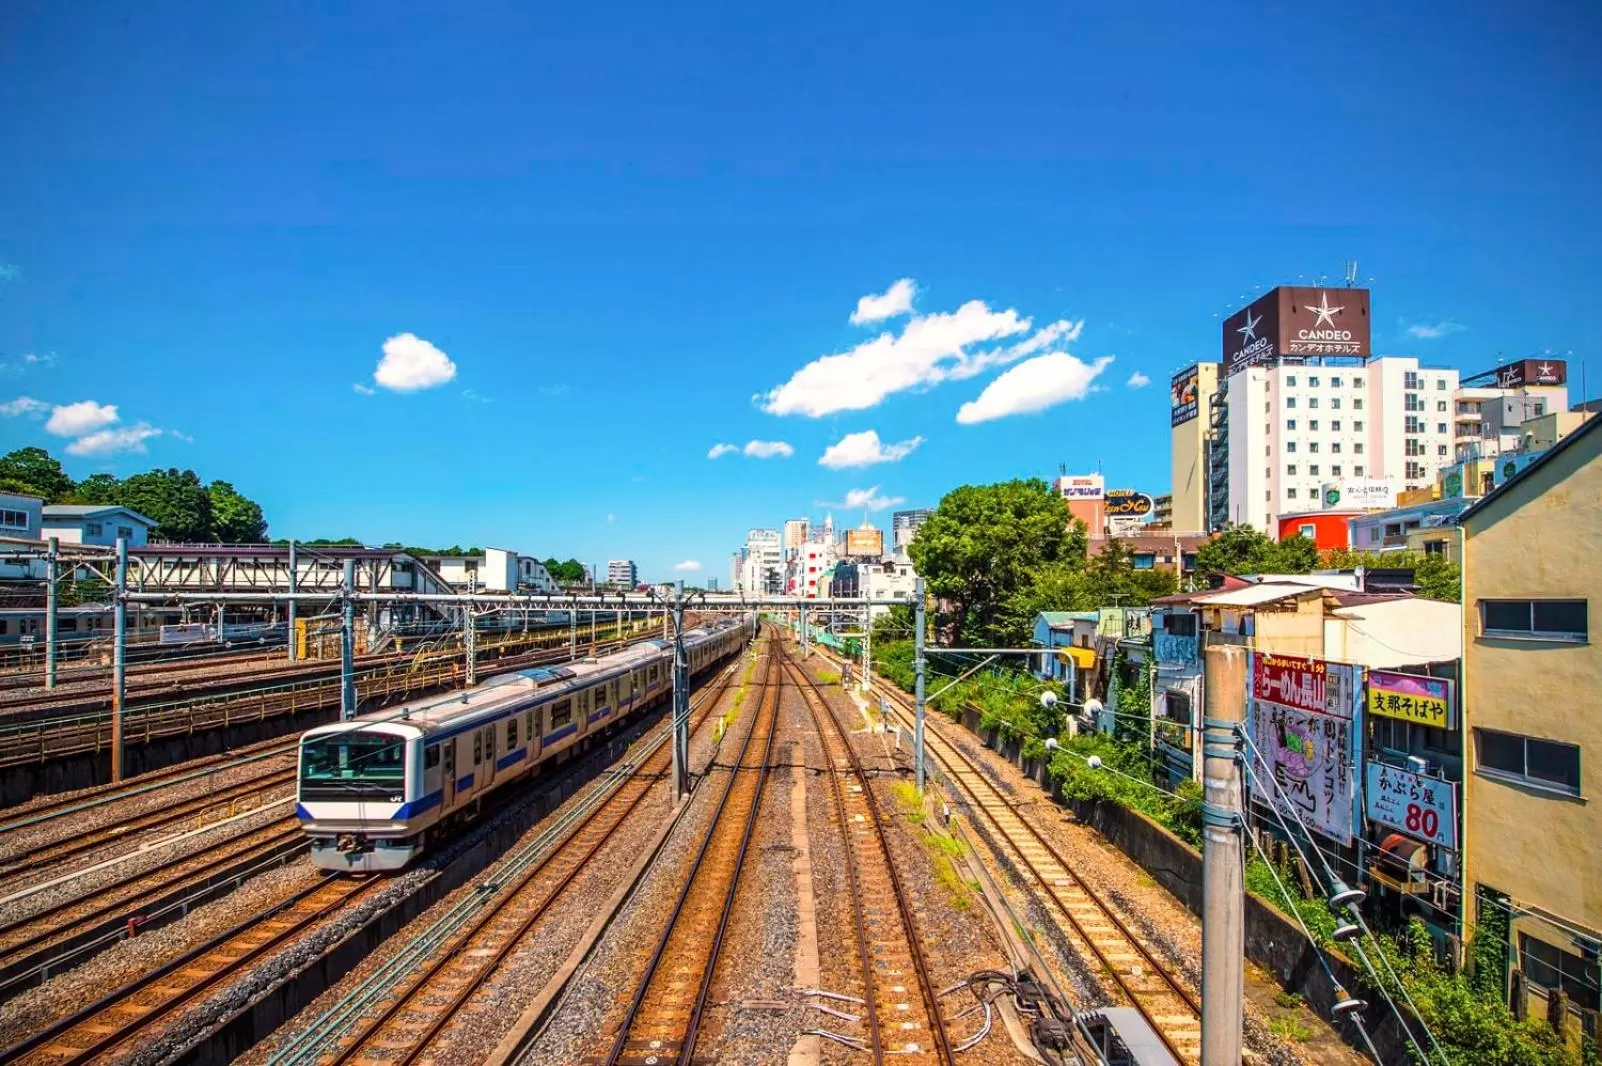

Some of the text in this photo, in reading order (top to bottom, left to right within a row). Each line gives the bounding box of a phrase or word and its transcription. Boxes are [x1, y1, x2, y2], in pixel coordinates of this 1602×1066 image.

[1298, 329, 1352, 340] CANDEO
[1232, 337, 1268, 361] CANDEO
[1289, 343, 1361, 354] カンデオホテルズ
[1262, 666, 1326, 711] らーめん長山
[1374, 692, 1444, 720] 支那そばや
[1379, 777, 1436, 806] かぶら屋
